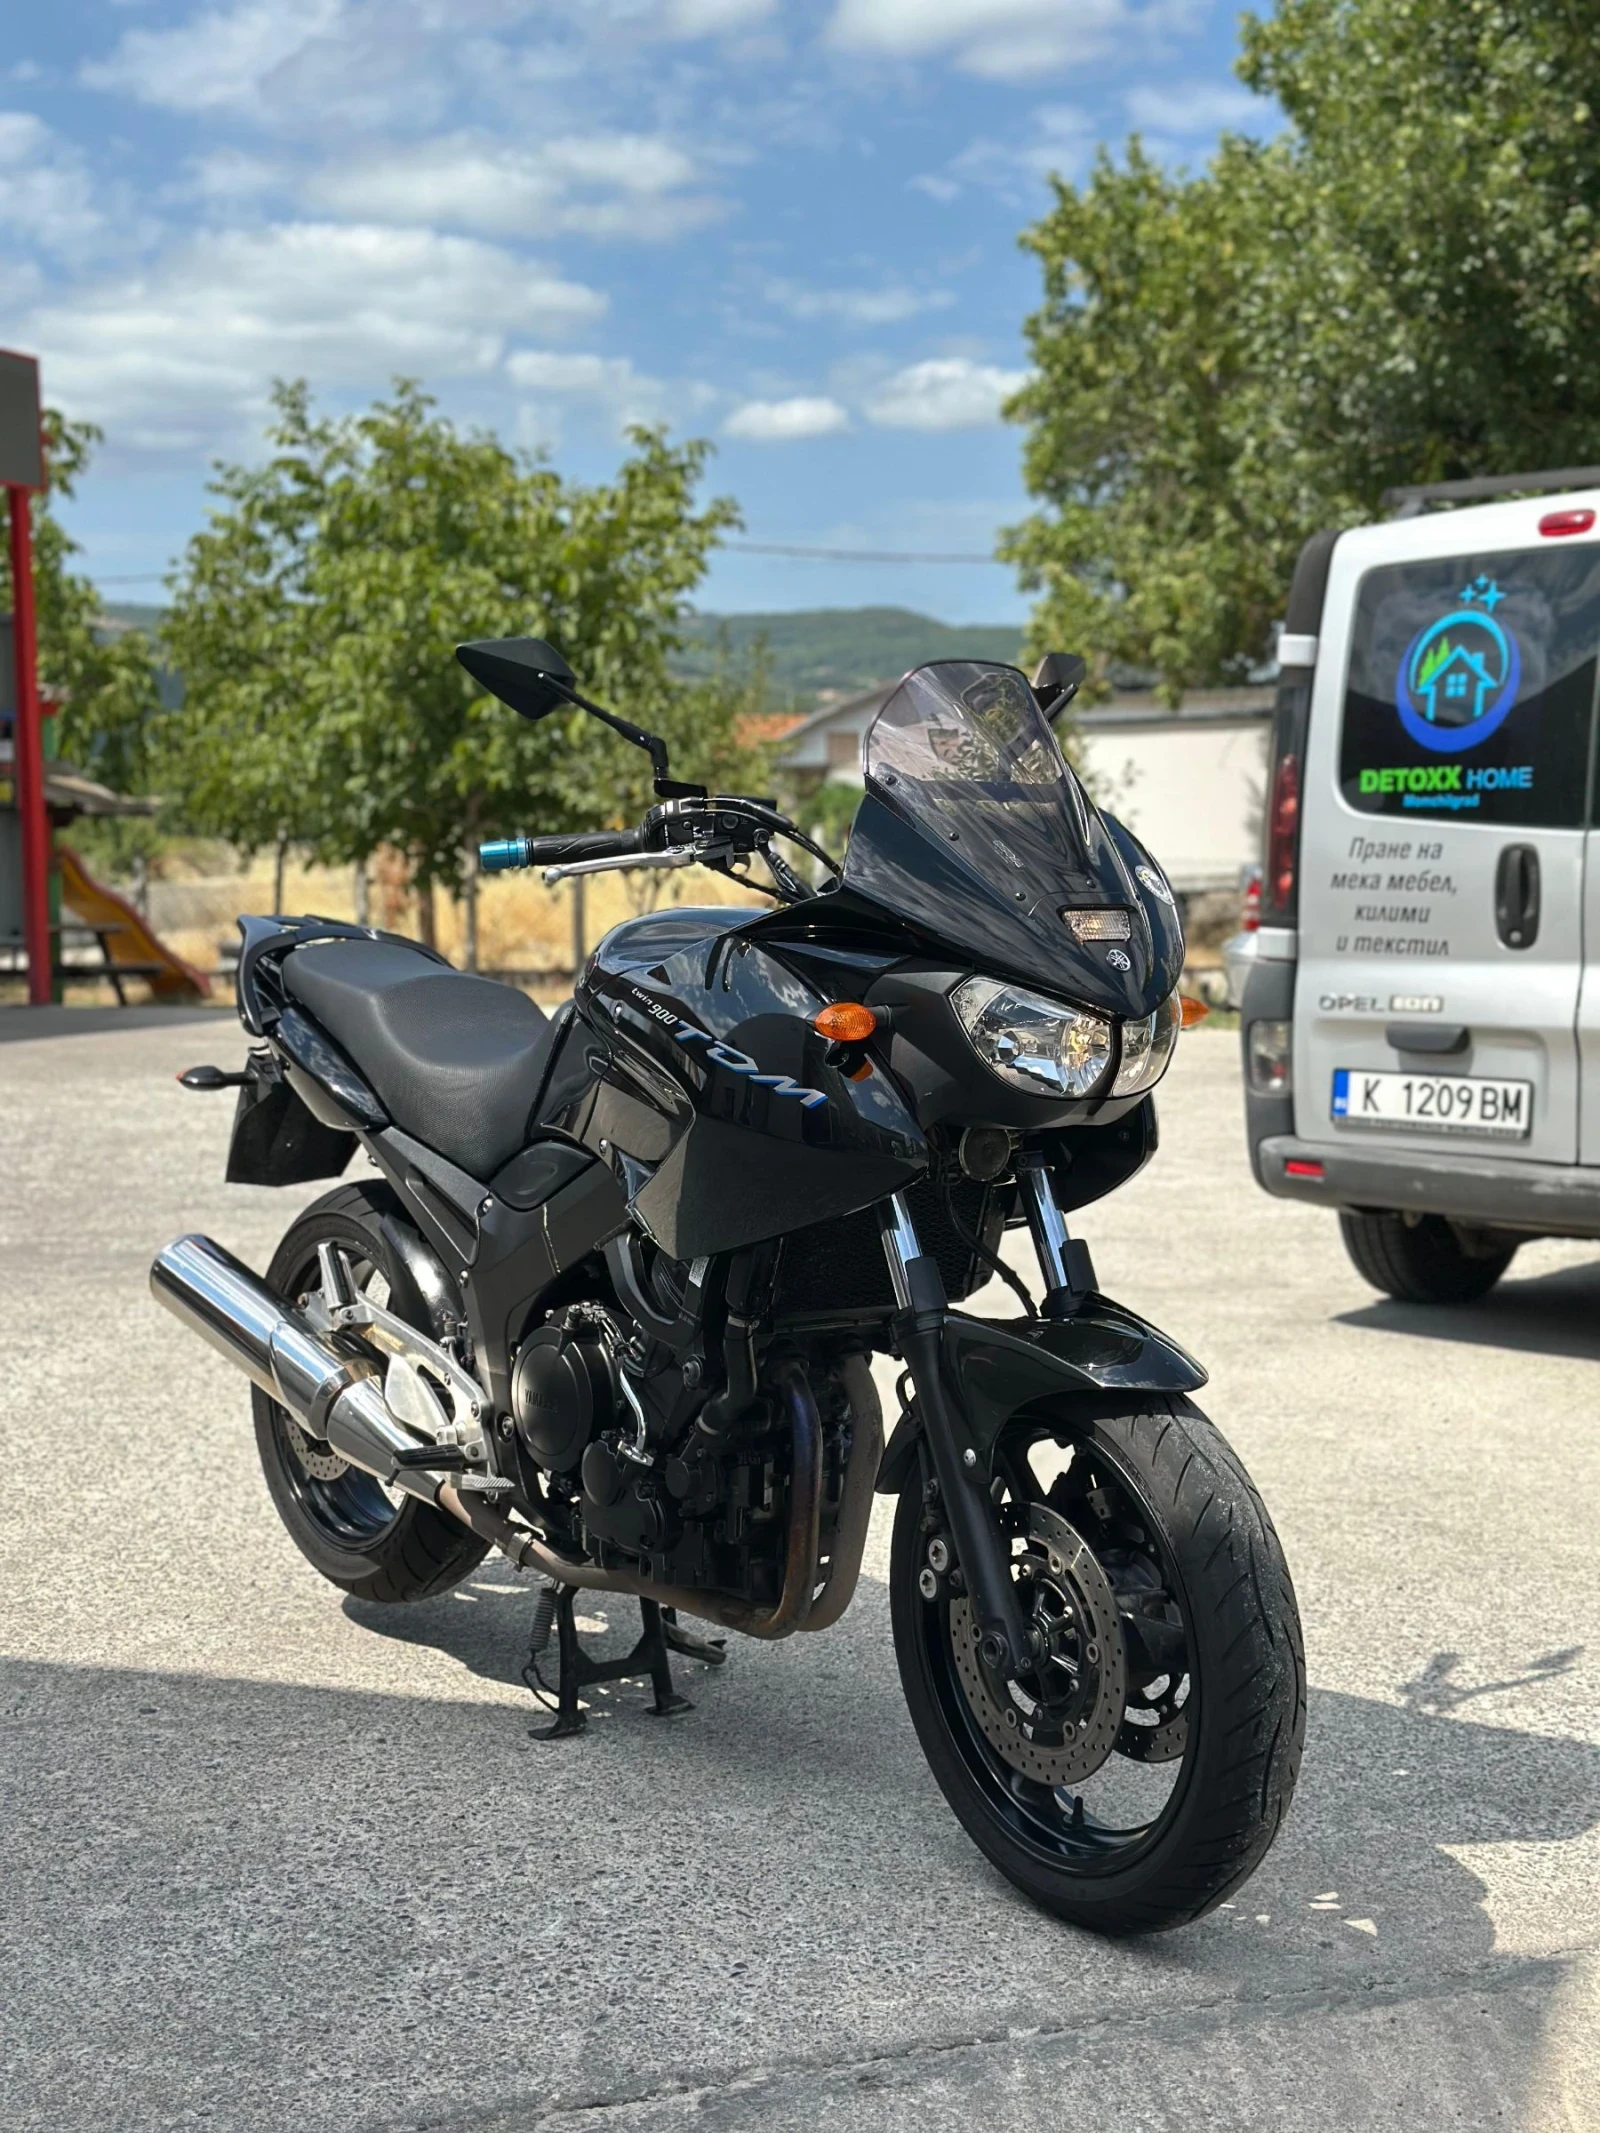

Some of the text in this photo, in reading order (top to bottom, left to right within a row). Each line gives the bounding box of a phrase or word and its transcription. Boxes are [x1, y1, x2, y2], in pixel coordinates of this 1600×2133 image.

[1359, 765, 1534, 793] DETOXX HOME
[1348, 836, 1444, 863] Пране на
[1330, 868, 1458, 896] мека мебел,
[1354, 904, 1431, 923] килими
[1336, 935, 1450, 956] и текстил
[1318, 994, 1385, 1012] OPEL
[631, 987, 829, 1110] twin 900 TDM
[1362, 1078, 1381, 1113] K
